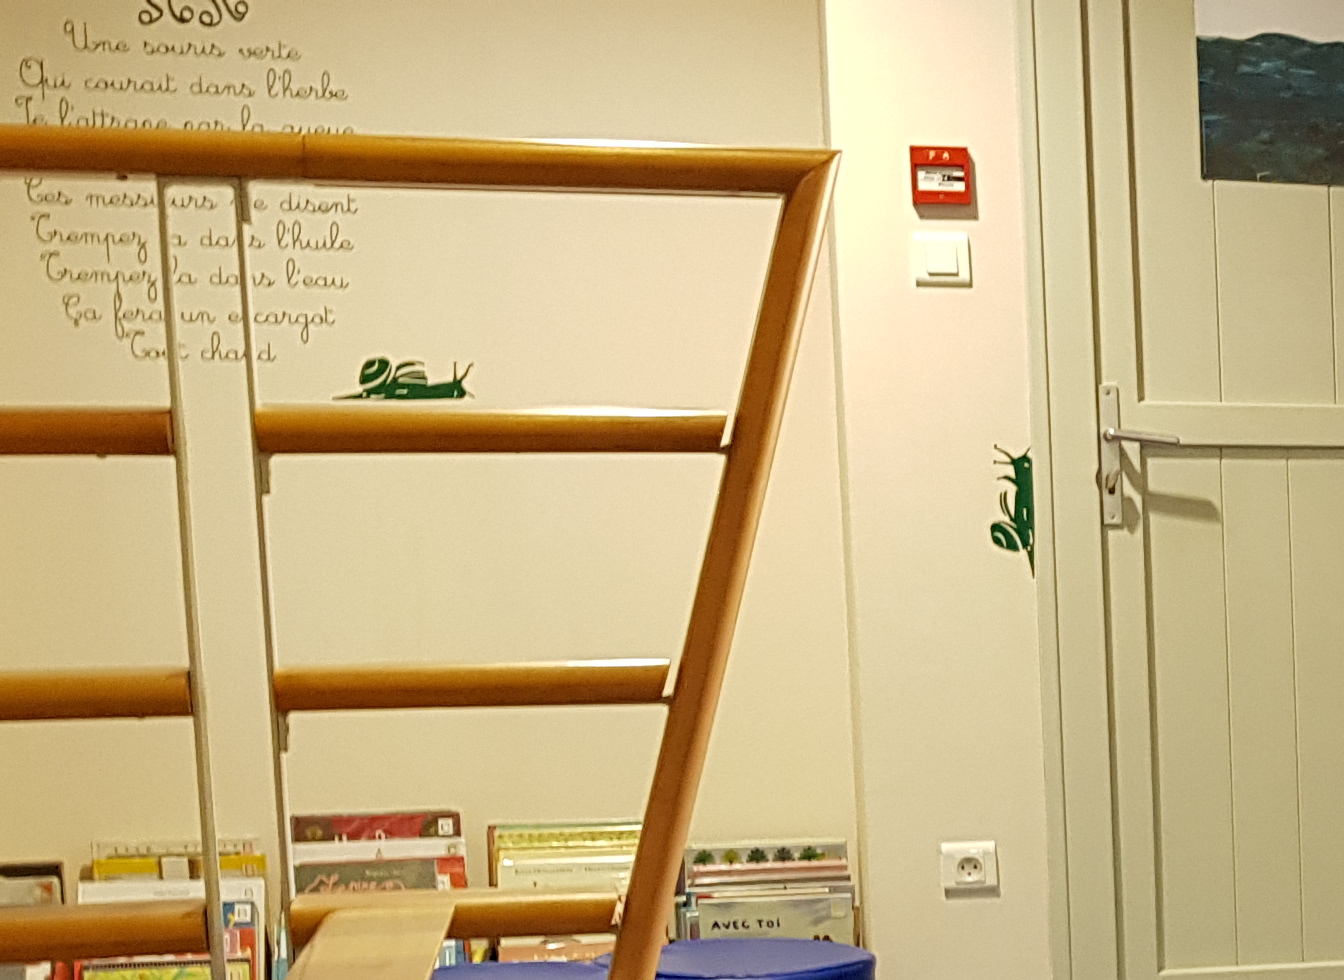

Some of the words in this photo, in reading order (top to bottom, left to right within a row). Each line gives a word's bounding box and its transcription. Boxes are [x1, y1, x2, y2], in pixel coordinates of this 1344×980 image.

[64, 19, 130, 51] Une
[143, 39, 225, 58] souris
[239, 41, 302, 62] verte
[19, 56, 71, 99] Qui
[85, 74, 177, 93] courait
[190, 76, 256, 98] dans
[267, 68, 349, 101] l'herbe
[86, 191, 218, 210] messiurs
[280, 193, 359, 215] disent
[31, 213, 148, 264] Trempez
[200, 228, 266, 249] das
[276, 220, 355, 250] l'huile
[41, 251, 157, 302] Trempez
[286, 258, 350, 289] l'eau
[114, 289, 165, 340] fera
[181, 309, 216, 324] un
[228, 304, 336, 343] ecargot
[711, 918, 750, 931] AVEC
